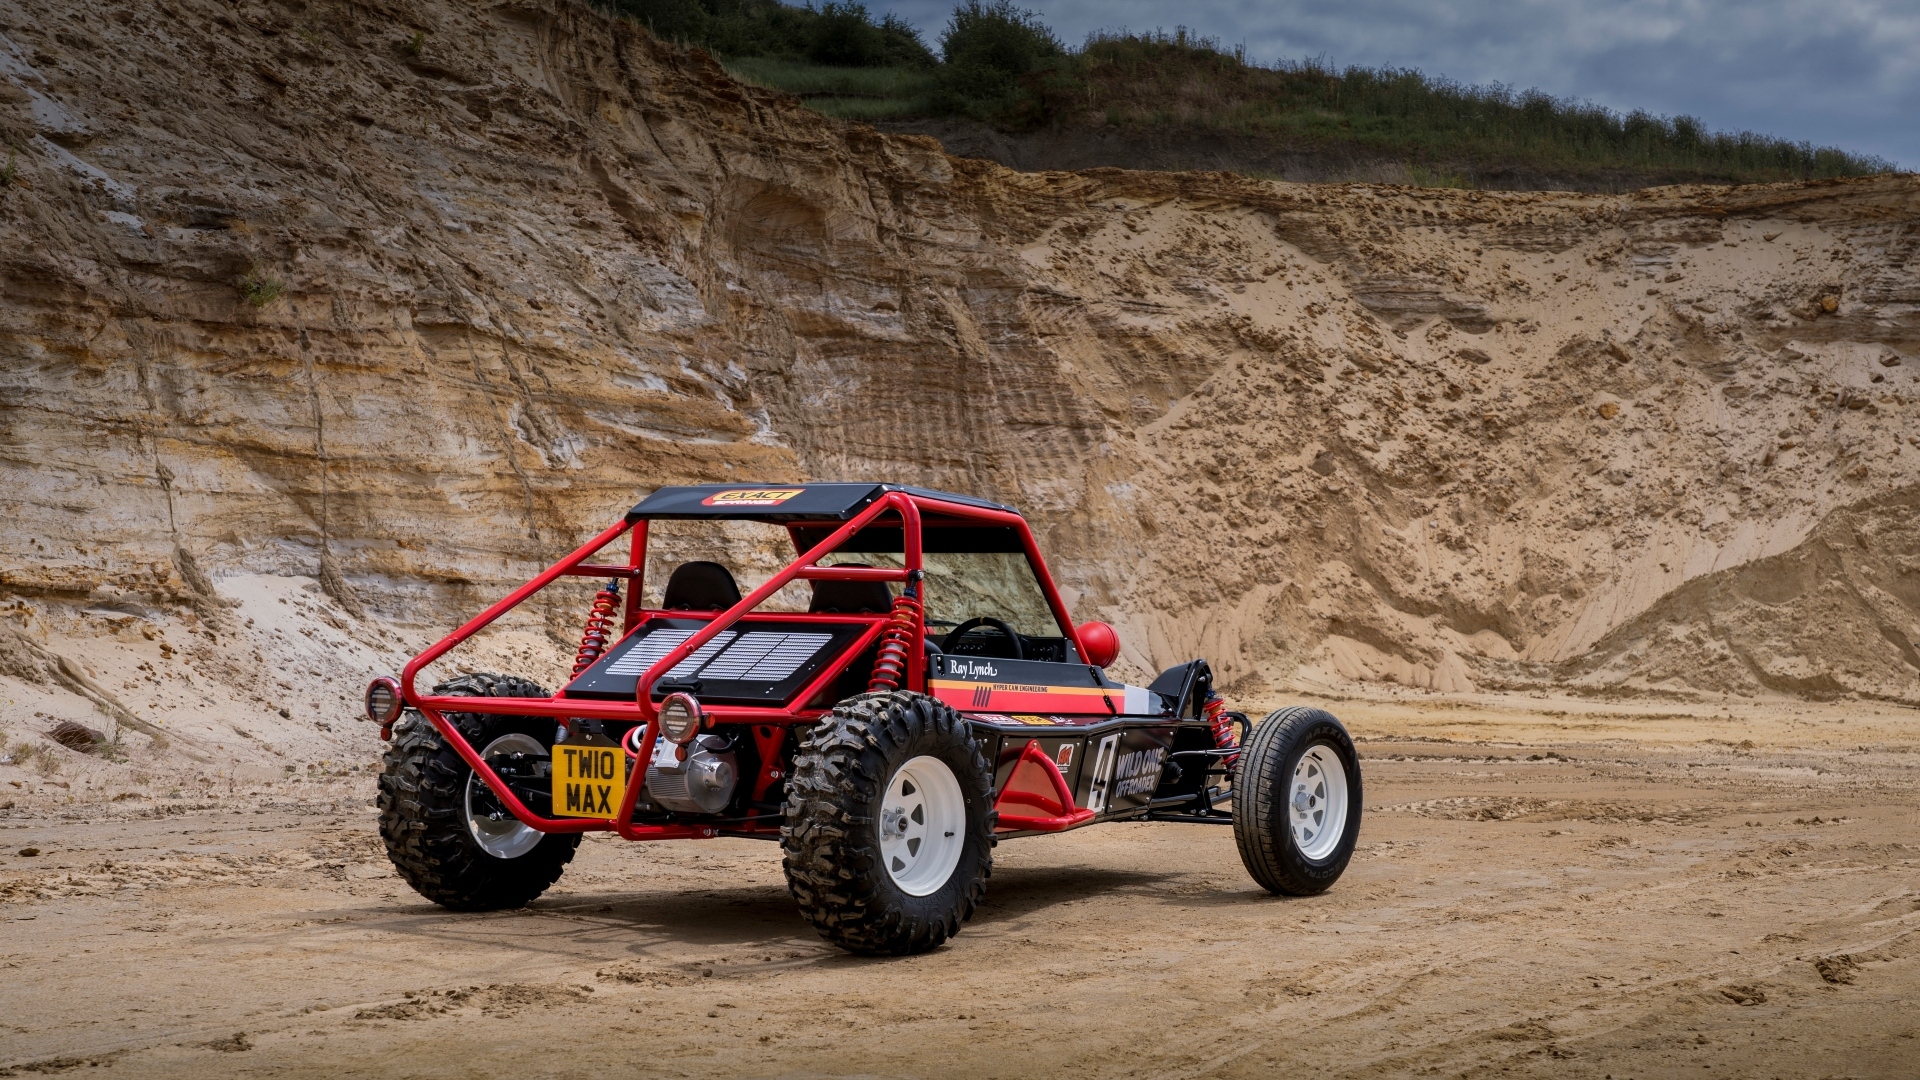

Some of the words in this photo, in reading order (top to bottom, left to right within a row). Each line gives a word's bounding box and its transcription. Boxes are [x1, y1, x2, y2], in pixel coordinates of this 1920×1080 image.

[950, 659, 968, 679] Ray
[969, 660, 998, 680] Lynch
[992, 683, 1008, 691] HYPER
[1009, 684, 1019, 692] CAM
[1019, 685, 1048, 693] ENGINEERING
[1304, 726, 1349, 747] MAXXIS
[1115, 750, 1143, 780] WILD
[1141, 746, 1165, 775] ONE
[1115, 774, 1156, 798] OFFROADER
[566, 783, 612, 814] MAX
